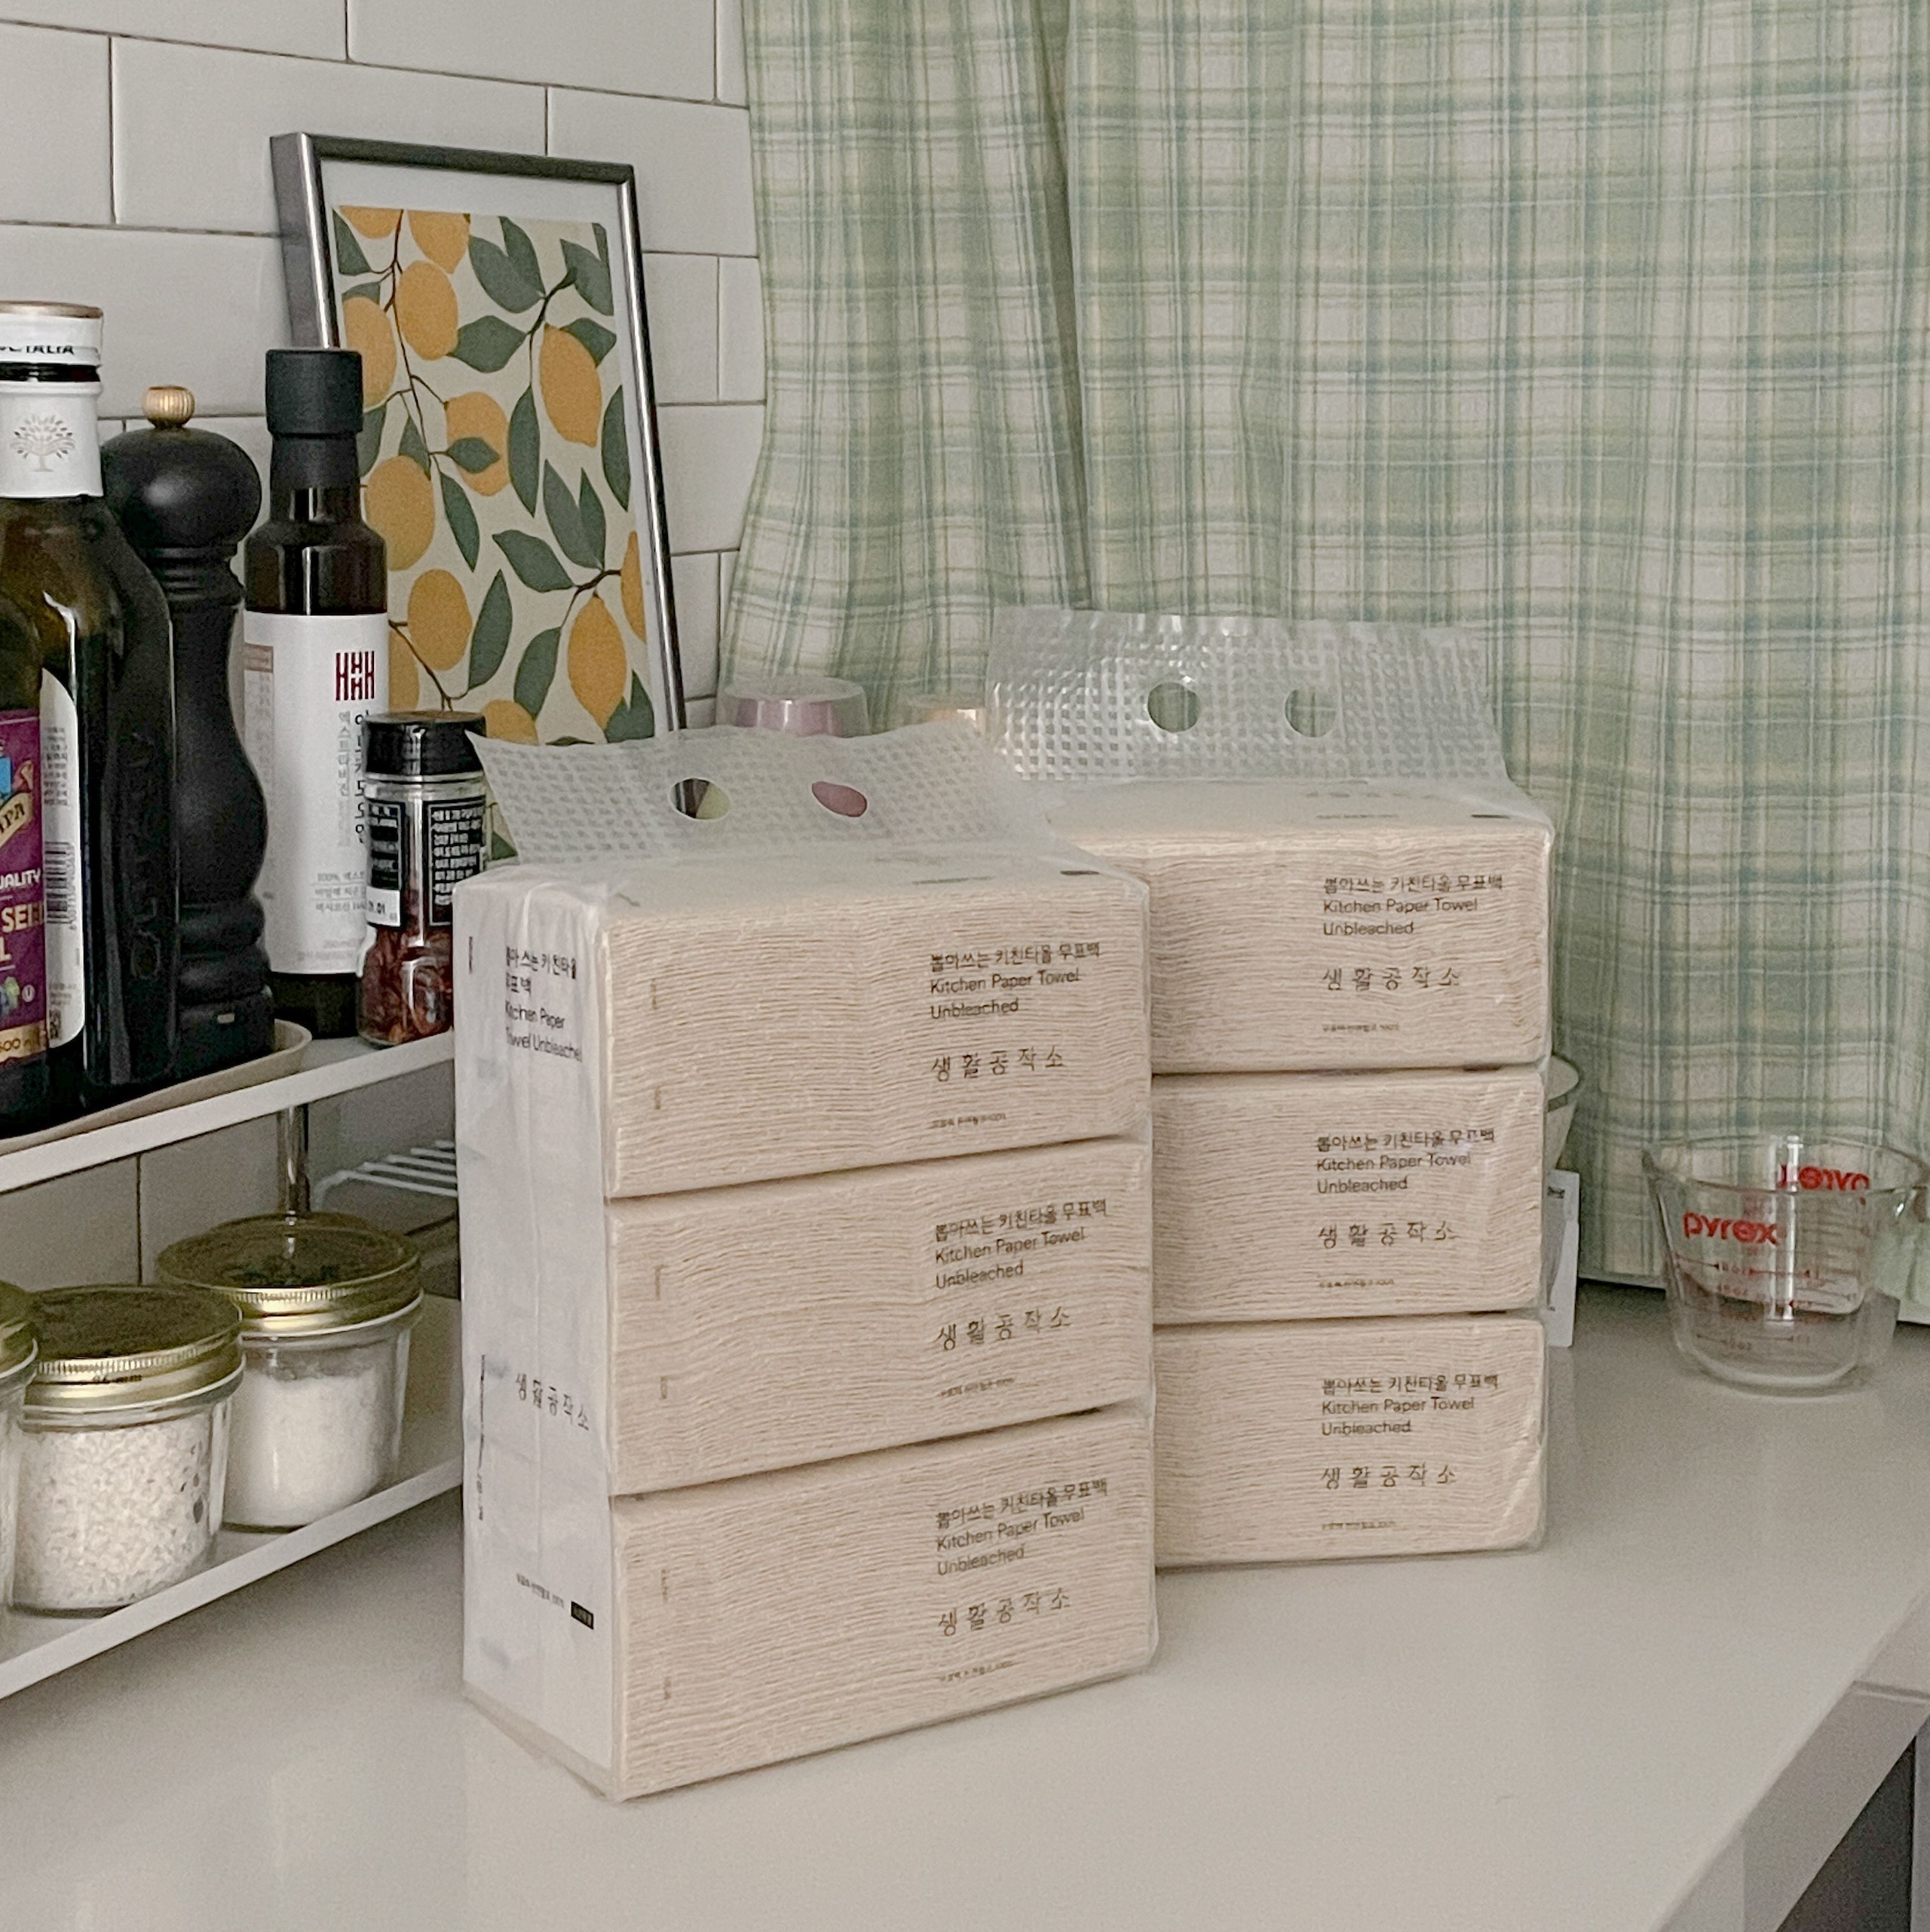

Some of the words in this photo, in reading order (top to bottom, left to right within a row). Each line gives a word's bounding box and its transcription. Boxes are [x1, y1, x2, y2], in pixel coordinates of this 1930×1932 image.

[1457, 875, 1503, 891] 무표백
[1324, 900, 1381, 913] Kitchen
[1386, 898, 1428, 914] Paper
[1433, 897, 1478, 912] Towel
[1323, 920, 1414, 936] Unbleached
[1058, 942, 1099, 960] 무표백
[930, 979, 986, 994] Kitchen
[992, 973, 1032, 989] Paper
[1037, 968, 1080, 986] Towel
[1322, 966, 1460, 992] 생활공작소
[540, 1007, 565, 1029] Paper
[930, 998, 1019, 1020] Unbleached
[931, 1045, 1067, 1082] 생활공작소
[1317, 1158, 1375, 1171] Kitchen
[1380, 1155, 1423, 1170] Paper
[1426, 1152, 1472, 1167] Towel
[1317, 1176, 1408, 1194] Unbleached
[1063, 1198, 1107, 1220] 무표백
[1319, 1220, 1460, 1250] 생활공작소
[1683, 1212, 1778, 1246] pyrex
[936, 1244, 991, 1265] Kitchen
[996, 1237, 1038, 1254] Paper
[1041, 1227, 1085, 1246] Towel
[936, 1260, 1024, 1290] Unbleached
[937, 1306, 1071, 1351] 생활공작소
[1322, 1400, 1378, 1415] Kitchen
[1383, 1398, 1426, 1412] Paper
[1430, 1397, 1475, 1411] Towel
[1322, 1421, 1412, 1436] Unbleached
[1320, 1461, 1457, 1490] 생활공작소
[936, 1531, 993, 1552] Kitchen
[997, 1520, 1038, 1538] Paper
[1043, 1508, 1084, 1528] Towel
[938, 1543, 1025, 1576] Unbleached
[938, 1587, 1071, 1637] 생활공작소
